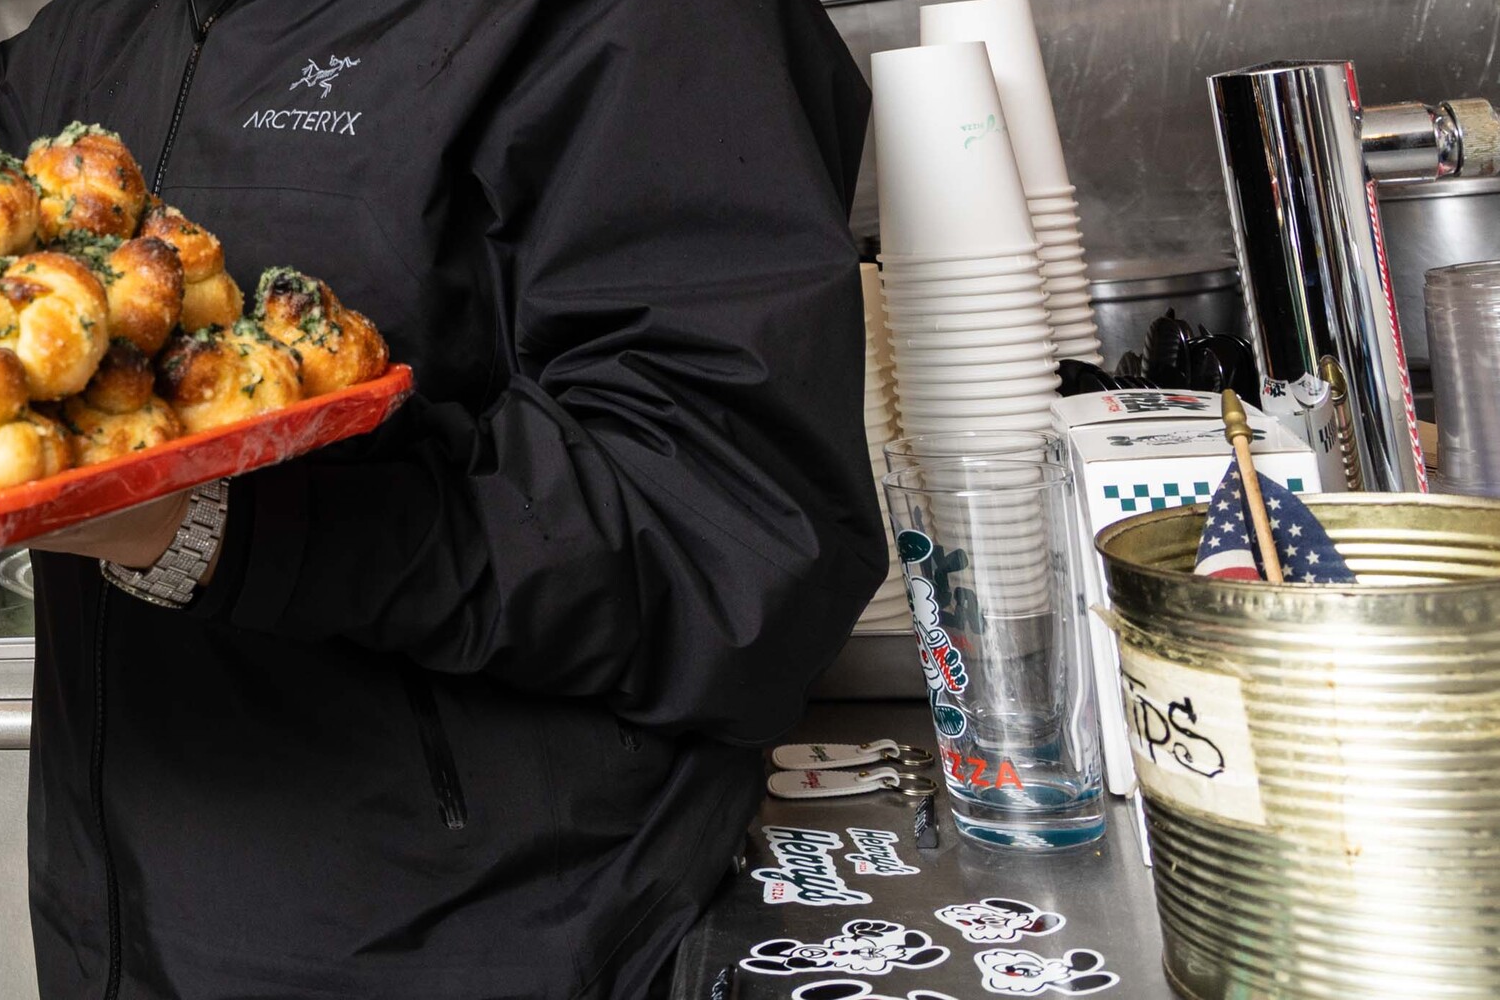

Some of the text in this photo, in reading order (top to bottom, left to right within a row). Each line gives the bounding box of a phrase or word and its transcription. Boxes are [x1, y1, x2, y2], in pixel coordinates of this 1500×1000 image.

[243, 109, 362, 136] ARC'TERYX
[758, 827, 864, 903] Henry's
[851, 829, 915, 874] Henry's
